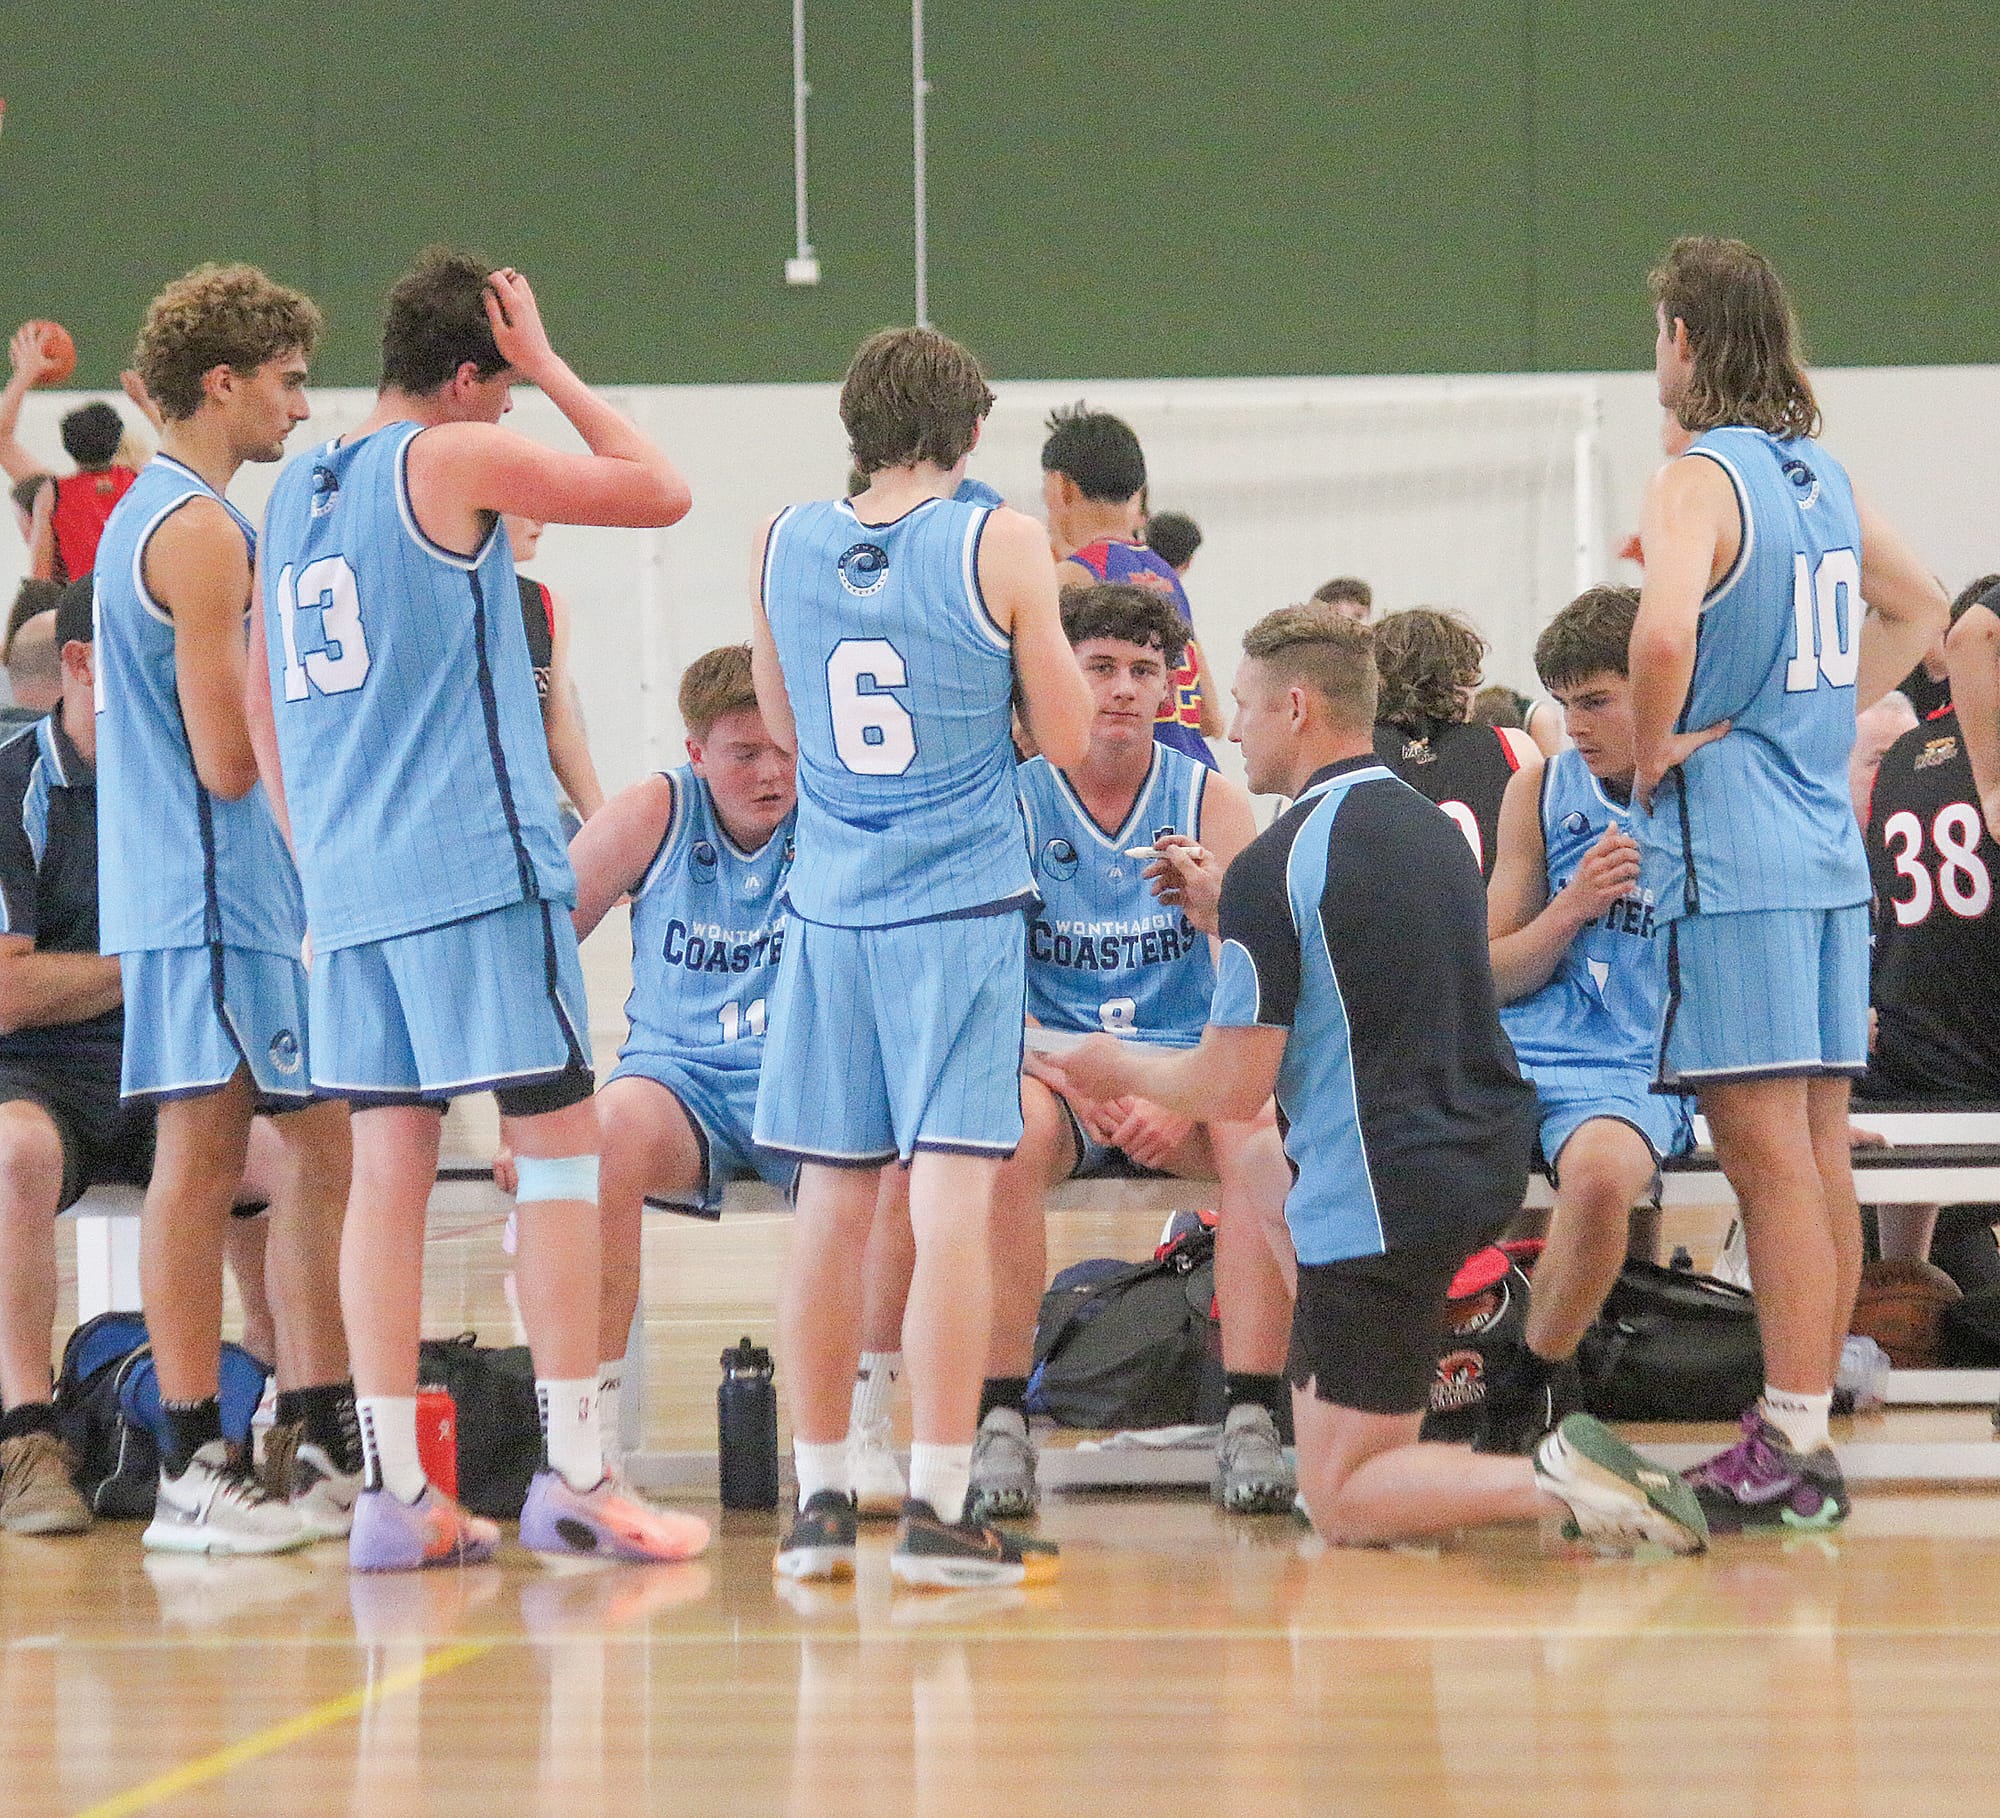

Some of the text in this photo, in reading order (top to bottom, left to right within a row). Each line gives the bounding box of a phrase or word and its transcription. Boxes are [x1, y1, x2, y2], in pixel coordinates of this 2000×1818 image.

[276, 553, 373, 703] 13
[1784, 547, 1858, 692] 10
[825, 637, 920, 777] 6
[1884, 801, 1992, 927] 38
[662, 918, 785, 973] COASTE
[1028, 913, 1196, 972] COASTERS
[1056, 914, 1173, 936] WONTHAGGI
[717, 998, 767, 1045] 11
[1098, 997, 1137, 1035] 8
